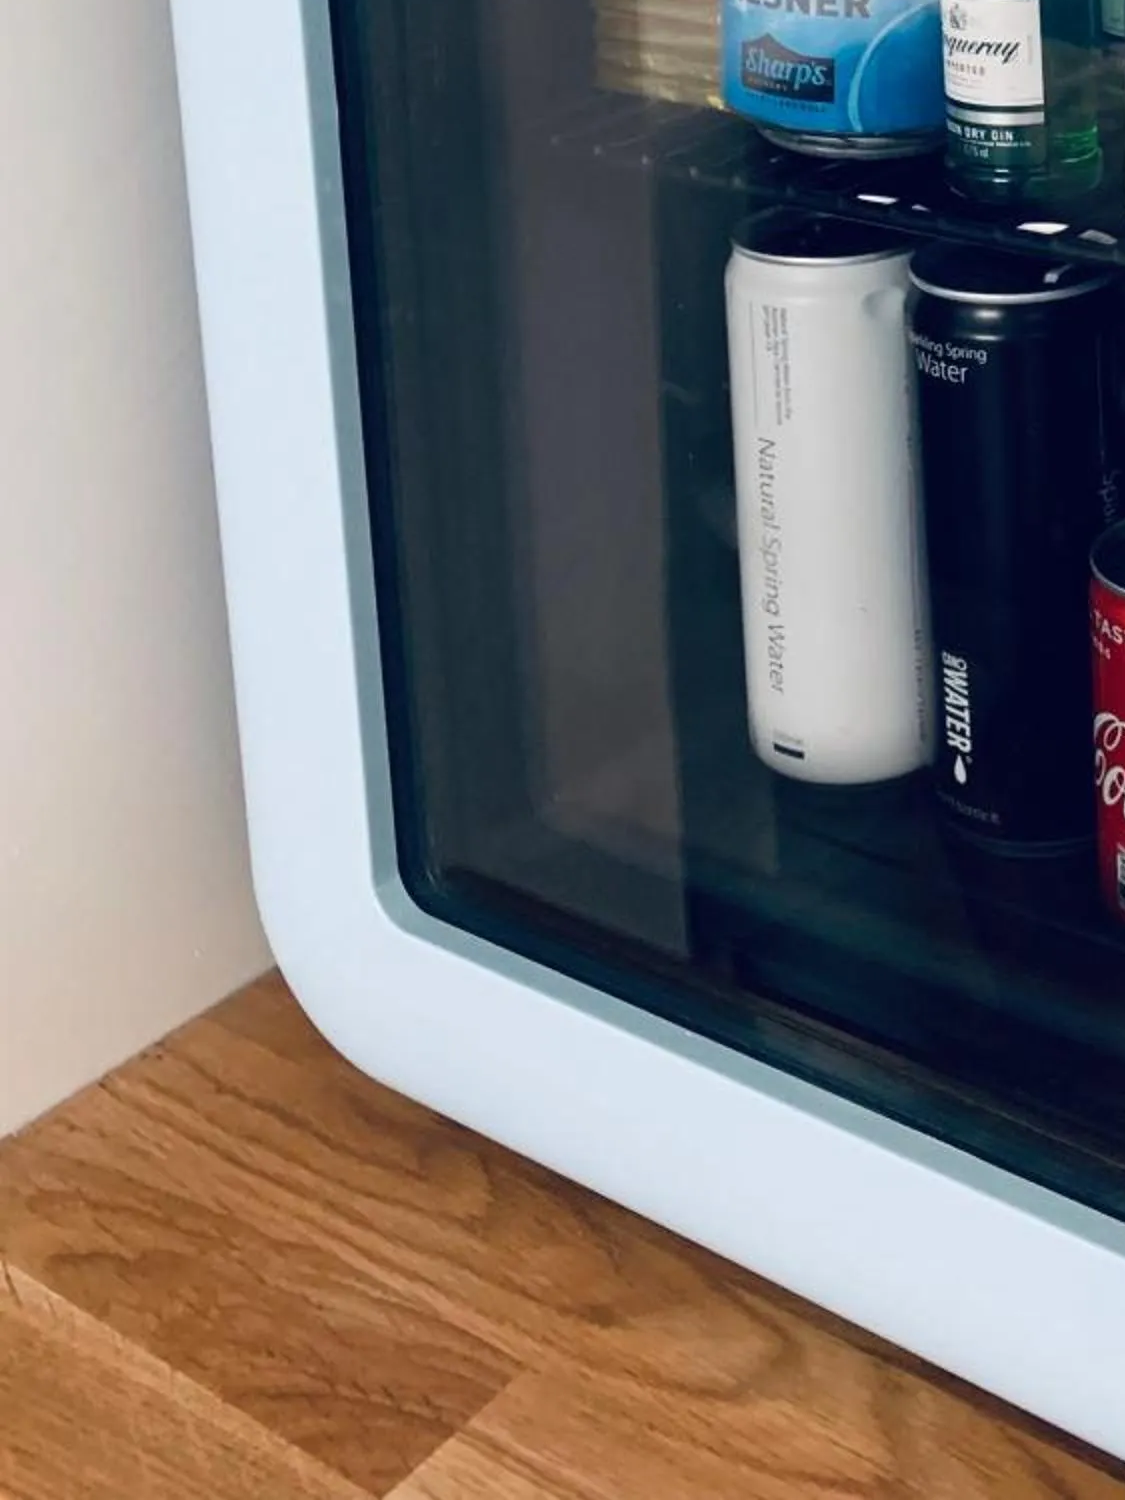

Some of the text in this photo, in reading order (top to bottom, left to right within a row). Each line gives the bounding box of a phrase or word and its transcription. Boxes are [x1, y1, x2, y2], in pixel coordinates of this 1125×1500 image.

[745, 47, 829, 91] Sharp's
[943, 33, 1021, 66] queray
[991, 129, 1014, 141] GIN
[915, 348, 969, 384] Water
[945, 342, 987, 365] Spring
[758, 436, 781, 531] Natural
[761, 534, 783, 618] Spring
[767, 624, 787, 695] Water
[943, 667, 972, 753] WATER
